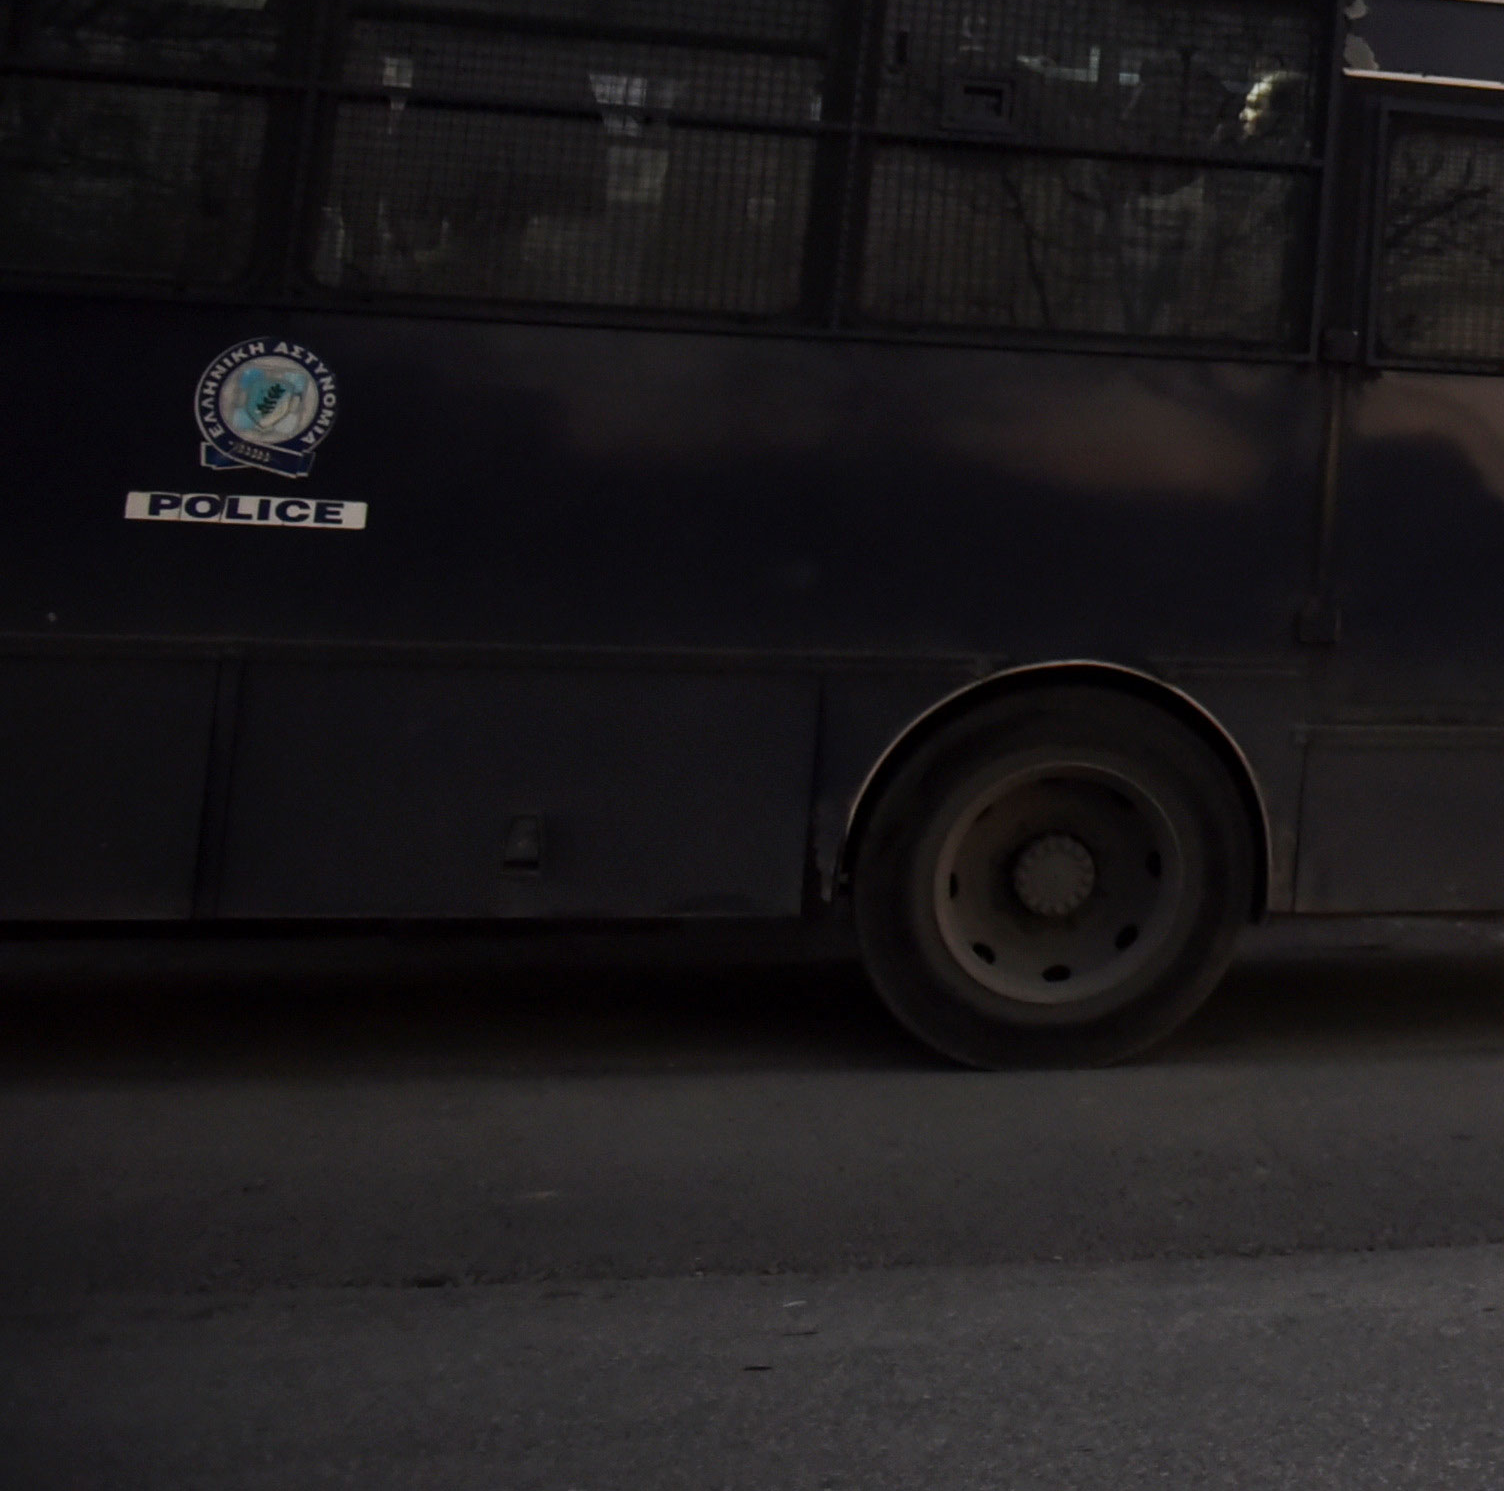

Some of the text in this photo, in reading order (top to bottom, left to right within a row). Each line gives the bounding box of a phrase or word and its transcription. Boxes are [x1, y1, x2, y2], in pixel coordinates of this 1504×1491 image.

[200, 340, 338, 445] ΕΛΛΗΝΙΚΗ ΑΣΤΥΝΟΜΙΑ
[147, 493, 345, 525] POLICE
